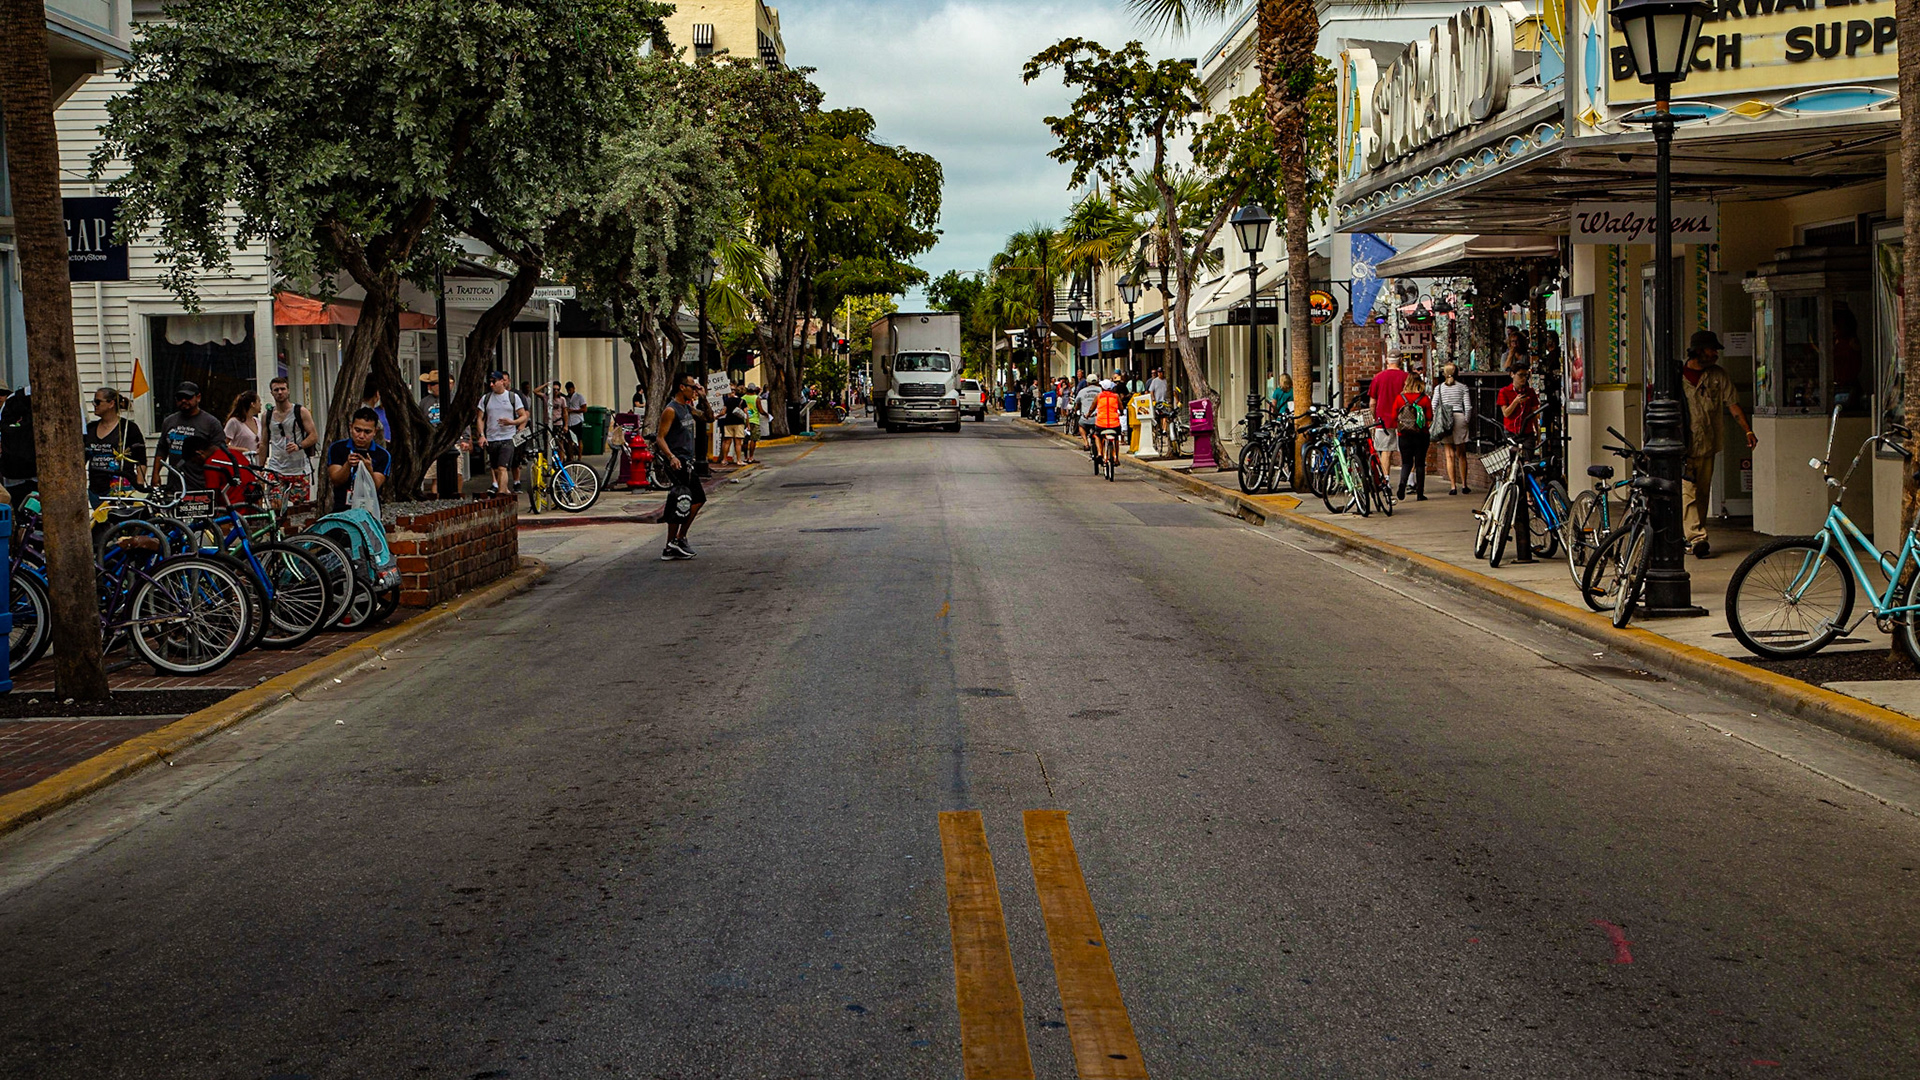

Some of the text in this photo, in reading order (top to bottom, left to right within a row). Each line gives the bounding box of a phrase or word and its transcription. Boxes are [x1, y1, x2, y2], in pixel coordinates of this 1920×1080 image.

[1610, 32, 1742, 81] BCH
[1576, 210, 1713, 242] Walgrens
[68, 253, 107, 262] actoryStore
[457, 285, 494, 295] TRATTORIA
